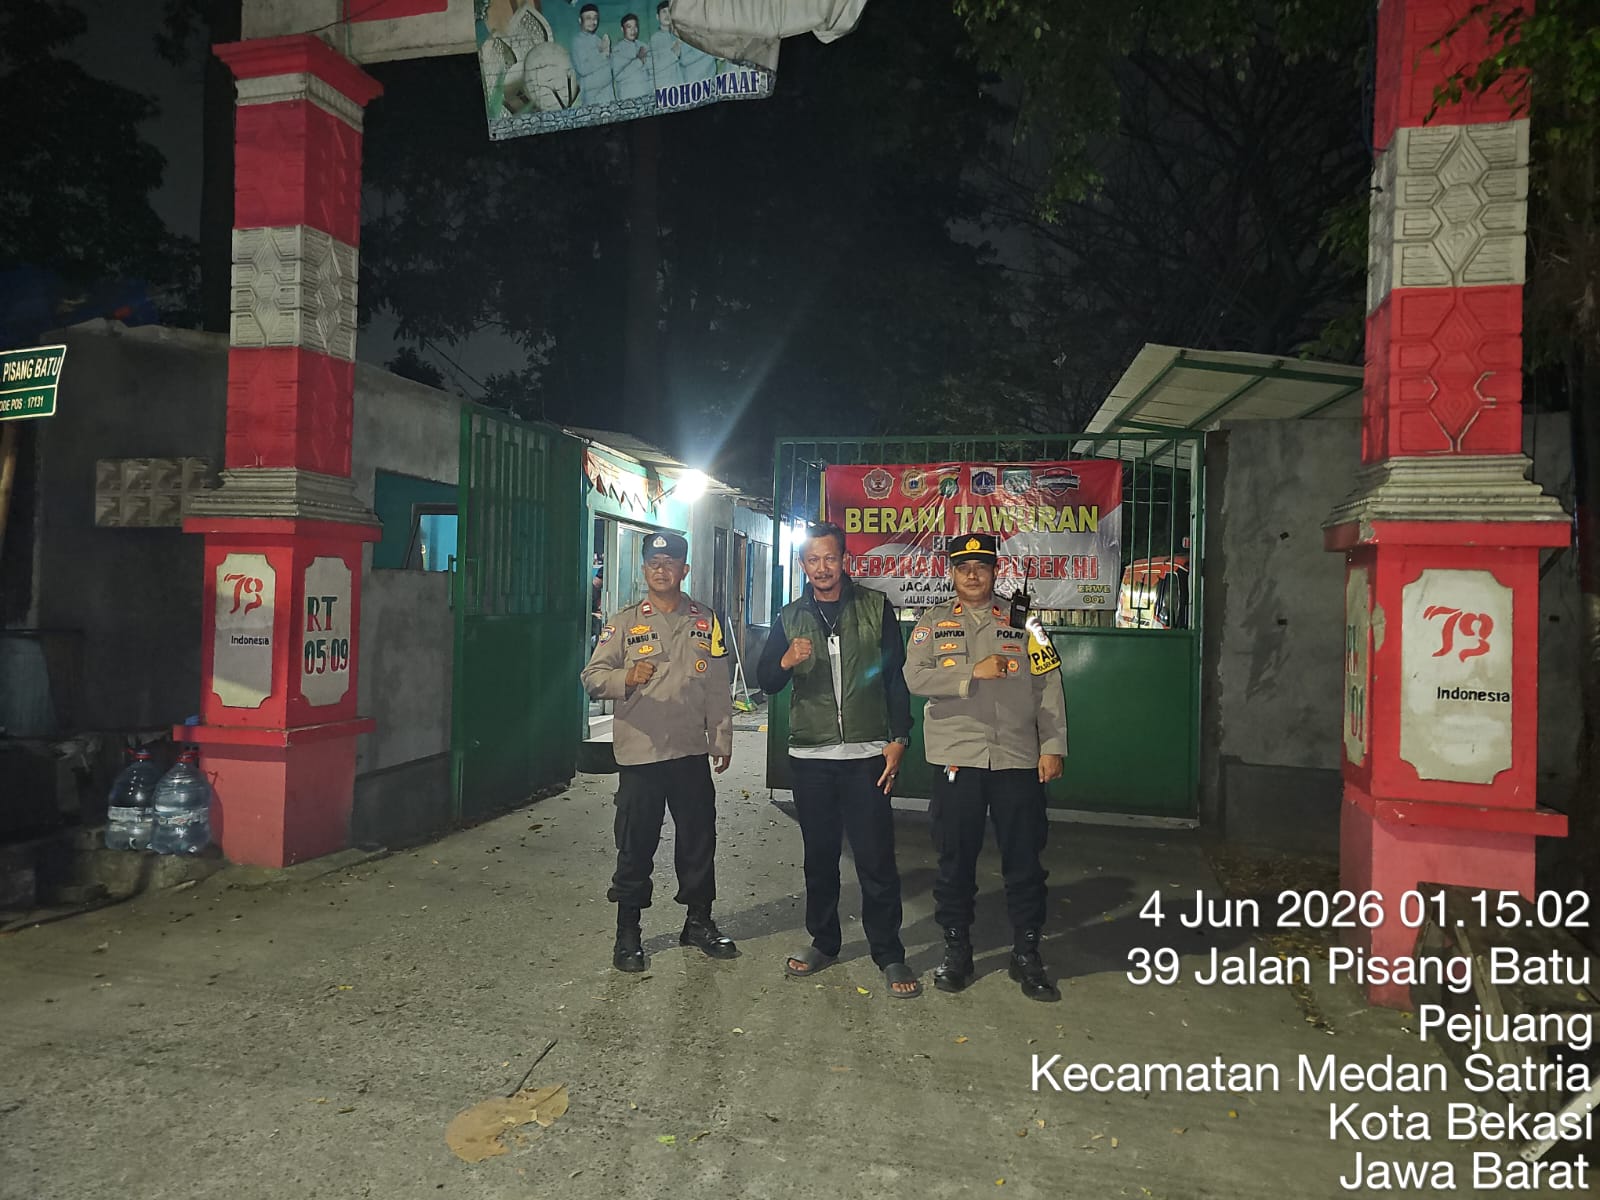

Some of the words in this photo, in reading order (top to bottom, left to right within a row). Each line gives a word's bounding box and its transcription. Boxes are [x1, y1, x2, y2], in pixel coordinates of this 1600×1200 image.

[655, 79, 711, 109] MOHON
[716, 71, 759, 96] MAAF
[3, 359, 34, 382] PISANG
[34, 356, 62, 378] BATU
[11, 398, 23, 410] POS
[27, 395, 44, 408] 17131
[844, 506, 946, 534] BERANI
[954, 504, 1098, 534] TAWURAN
[845, 554, 946, 578] LEBARAN
[997, 555, 1068, 579] OLSEK
[1072, 555, 1098, 579] HI
[899, 581, 931, 593] JAGA
[306, 596, 338, 632] RT
[231, 635, 270, 646] Indonesia
[690, 630, 712, 641] POLR
[996, 629, 1024, 640] POLRI
[1437, 686, 1511, 702] Indonesia
